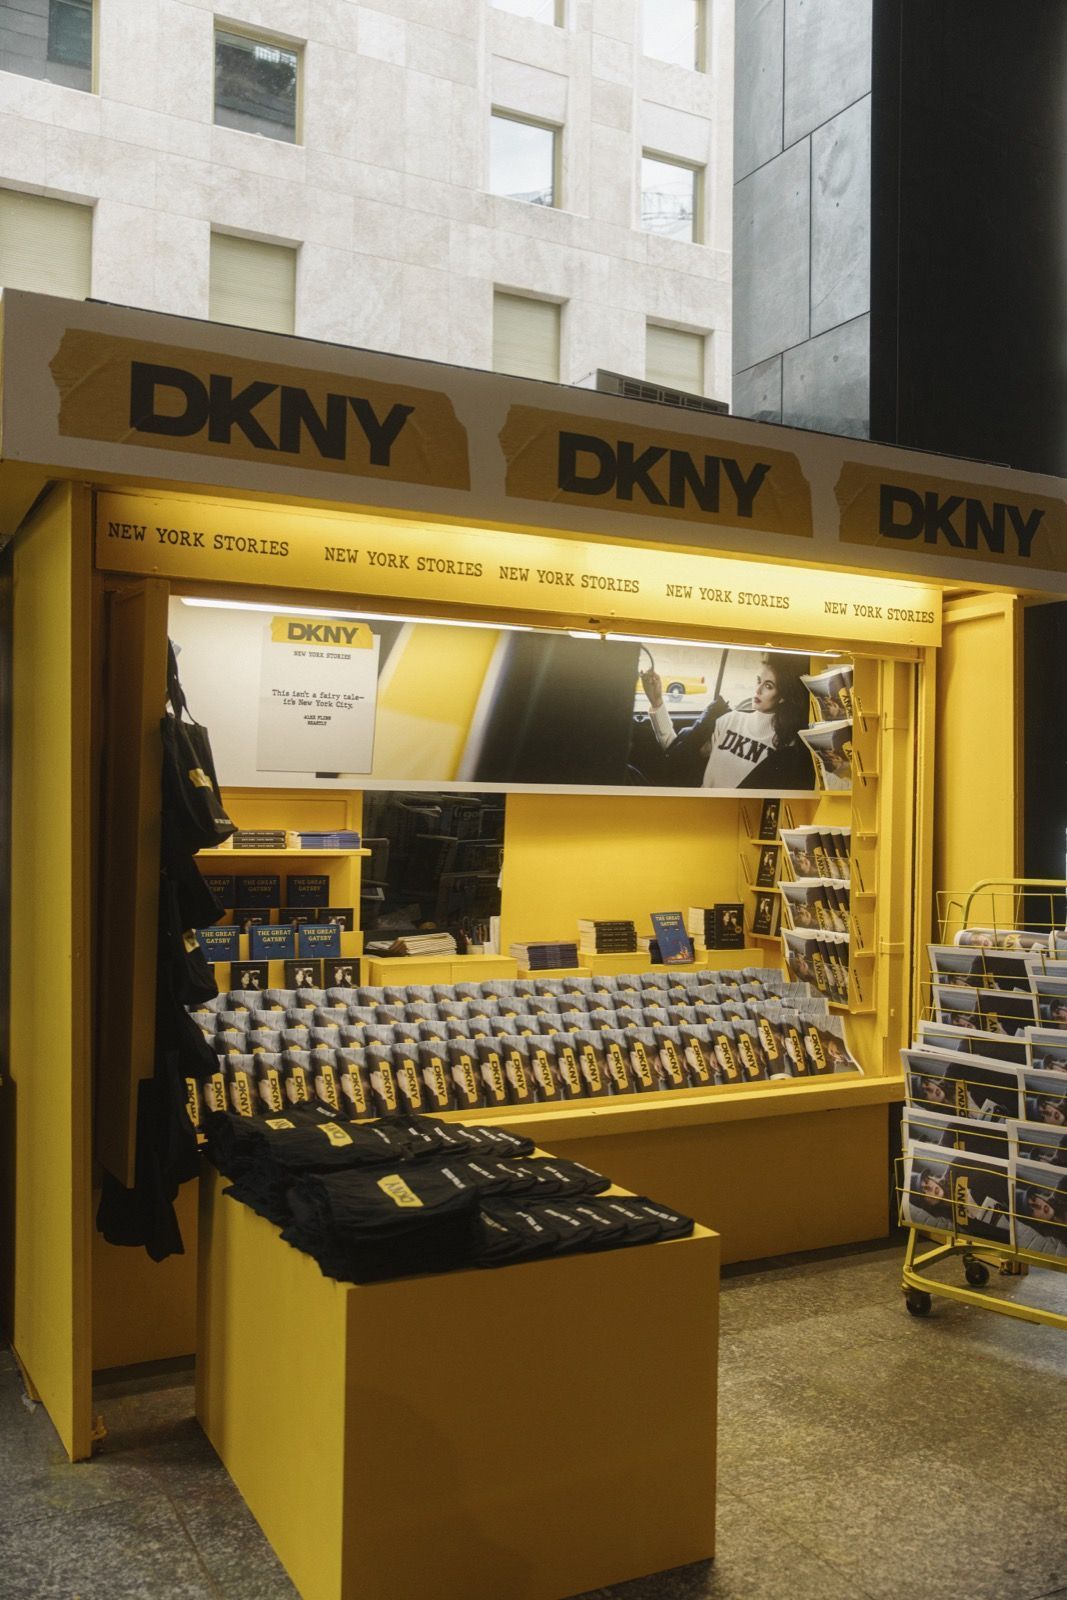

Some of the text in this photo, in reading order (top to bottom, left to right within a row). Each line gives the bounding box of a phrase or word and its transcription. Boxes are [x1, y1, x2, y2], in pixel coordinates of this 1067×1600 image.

[130, 360, 415, 466] DKNY
[557, 431, 771, 518] DKNY
[879, 484, 1046, 557] DKNY
[108, 522, 289, 557] NEW YORK STORIES
[324, 547, 483, 577] NEW YORK STORIES
[499, 566, 640, 593] NEW YORK STORIES
[666, 584, 790, 609] NEW YORK STORIES
[824, 601, 935, 624] NEW YORK STORIES
[288, 623, 359, 644] DKNY
[272, 689, 290, 697] This
[320, 691, 340, 701] fairy
[315, 700, 333, 708] York
[744, 1040, 757, 1070] DKNY
[763, 1026, 776, 1054] DKNY
[792, 1035, 804, 1066] DKNY
[812, 1034, 824, 1063] DKNY
[566, 1055, 578, 1087] DKNY
[587, 1053, 599, 1085] DKNY
[613, 1051, 626, 1081] DKNY
[636, 1049, 650, 1079] DKNY
[667, 1047, 680, 1077] DKNY
[693, 1045, 706, 1074] DKNY
[722, 1043, 735, 1071] DKNY
[295, 1076, 305, 1101] DKN
[351, 1073, 363, 1104] DKNY
[382, 1070, 394, 1102] DKNY
[407, 1068, 419, 1099] DKNY
[434, 1065, 446, 1097] DKNY
[464, 1063, 475, 1095] DKNY
[492, 1061, 503, 1092] DKNY
[513, 1058, 525, 1091] DKNY
[540, 1057, 552, 1091] DKNY
[214, 1082, 224, 1108] DKN
[238, 1080, 250, 1114] DKNY
[270, 1078, 280, 1111] DKNY
[325, 1074, 337, 1107] DKNY
